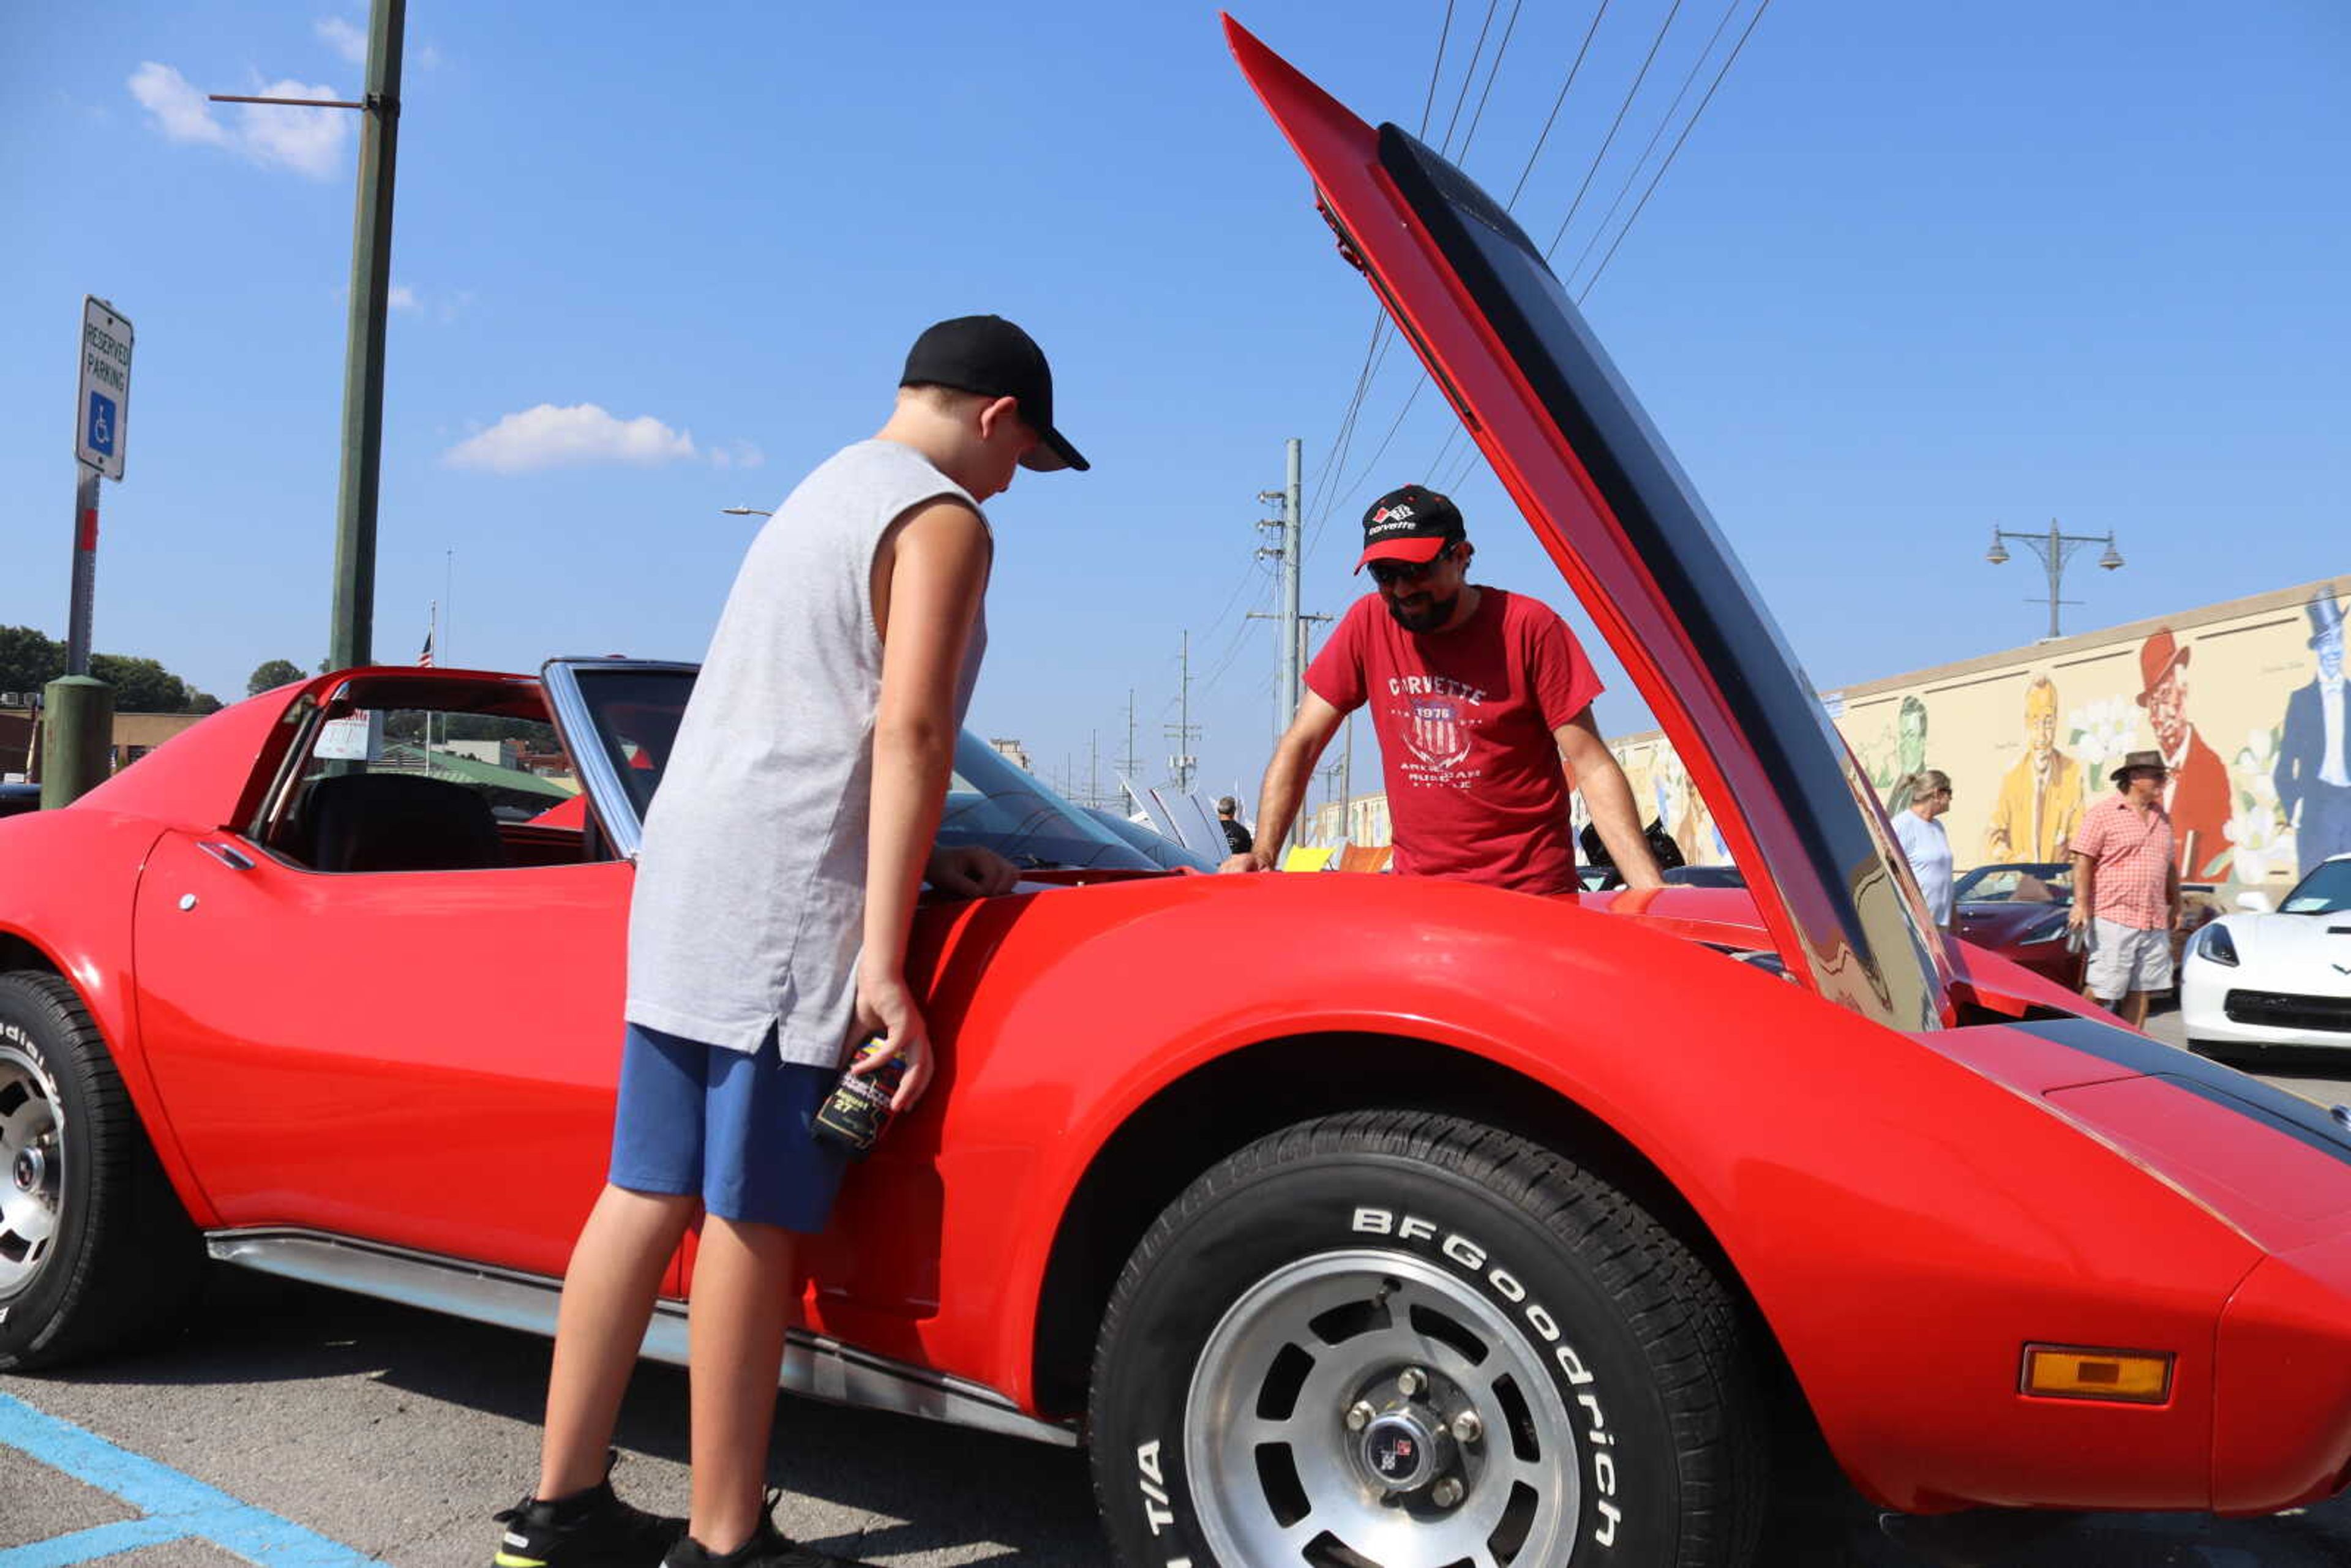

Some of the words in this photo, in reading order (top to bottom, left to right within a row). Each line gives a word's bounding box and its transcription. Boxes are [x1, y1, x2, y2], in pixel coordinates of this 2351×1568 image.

[87, 323, 129, 365] RESERVED
[87, 352, 124, 391] PARKING
[1368, 521, 1417, 536] corvette
[1352, 1207, 1621, 1548] BFGoodrich
[1137, 1439, 1174, 1536] T/A
